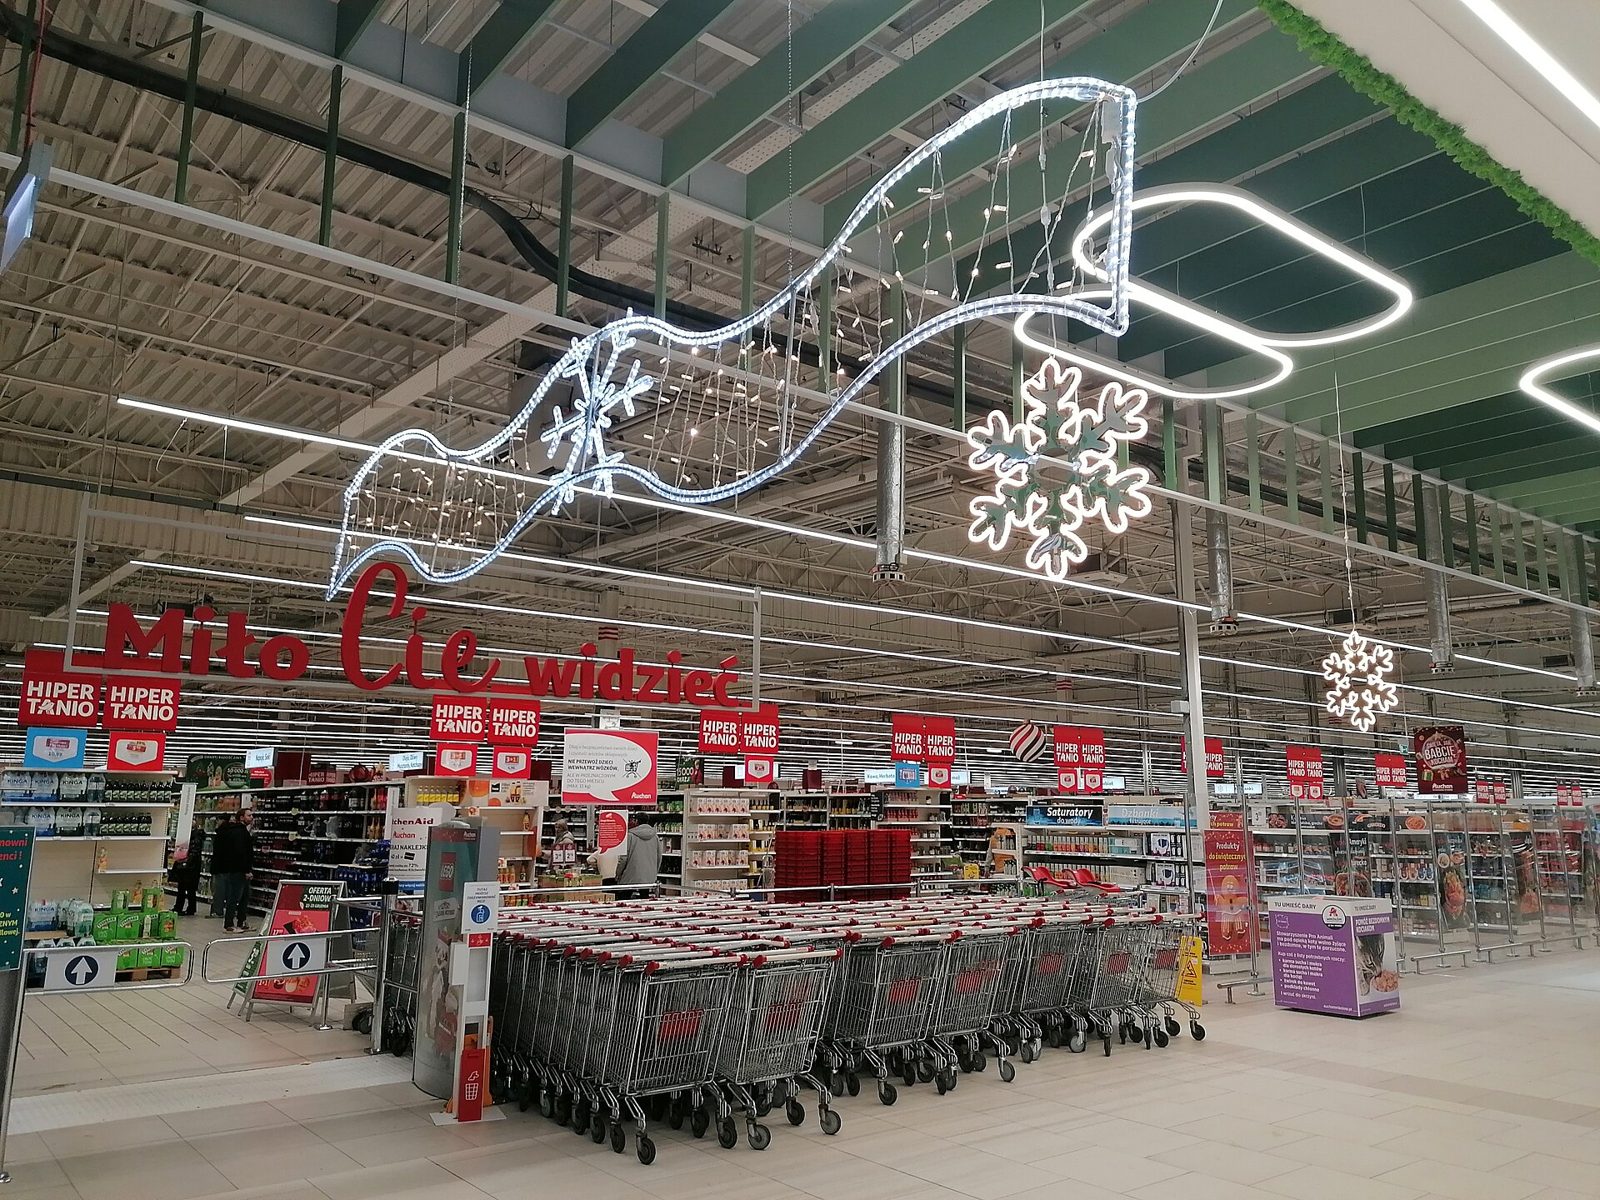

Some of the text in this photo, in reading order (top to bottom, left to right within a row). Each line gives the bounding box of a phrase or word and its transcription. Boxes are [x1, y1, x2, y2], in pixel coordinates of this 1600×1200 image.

[105, 602, 310, 681] Miło
[524, 643, 740, 708] widzieć
[27, 681, 94, 700] HIPER
[111, 686, 174, 704] HIPER
[26, 699, 94, 717] TANIO
[111, 704, 174, 720] TANIO
[436, 704, 482, 720] HIPER
[493, 709, 536, 724] HIPER
[436, 719, 482, 734] TANIO
[493, 723, 536, 737] TANIO
[703, 720, 737, 734] HIPER
[744, 723, 776, 736] HIPER
[703, 733, 737, 745] TANIO
[744, 736, 776, 748] TANIO
[895, 733, 922, 744] HIPER
[928, 735, 953, 746] HIPER
[895, 744, 922, 754] TANIO
[928, 746, 953, 756] TANIO
[1056, 743, 1078, 753] HIPER
[1082, 744, 1103, 754] HIPER
[1425, 746, 1456, 760] BABCIĘ
[1057, 752, 1078, 762] TANIO
[1083, 754, 1103, 763] TANIO
[1205, 753, 1222, 762] HIPER
[1206, 762, 1223, 770] TANIO
[1288, 760, 1304, 768] HIPER
[1289, 768, 1305, 776] TANIO
[1307, 769, 1322, 777] TANIO
[1047, 807, 1093, 819] Saturatory
[1121, 808, 1159, 818] Dzbanki
[1216, 842, 1240, 851] Produkty
